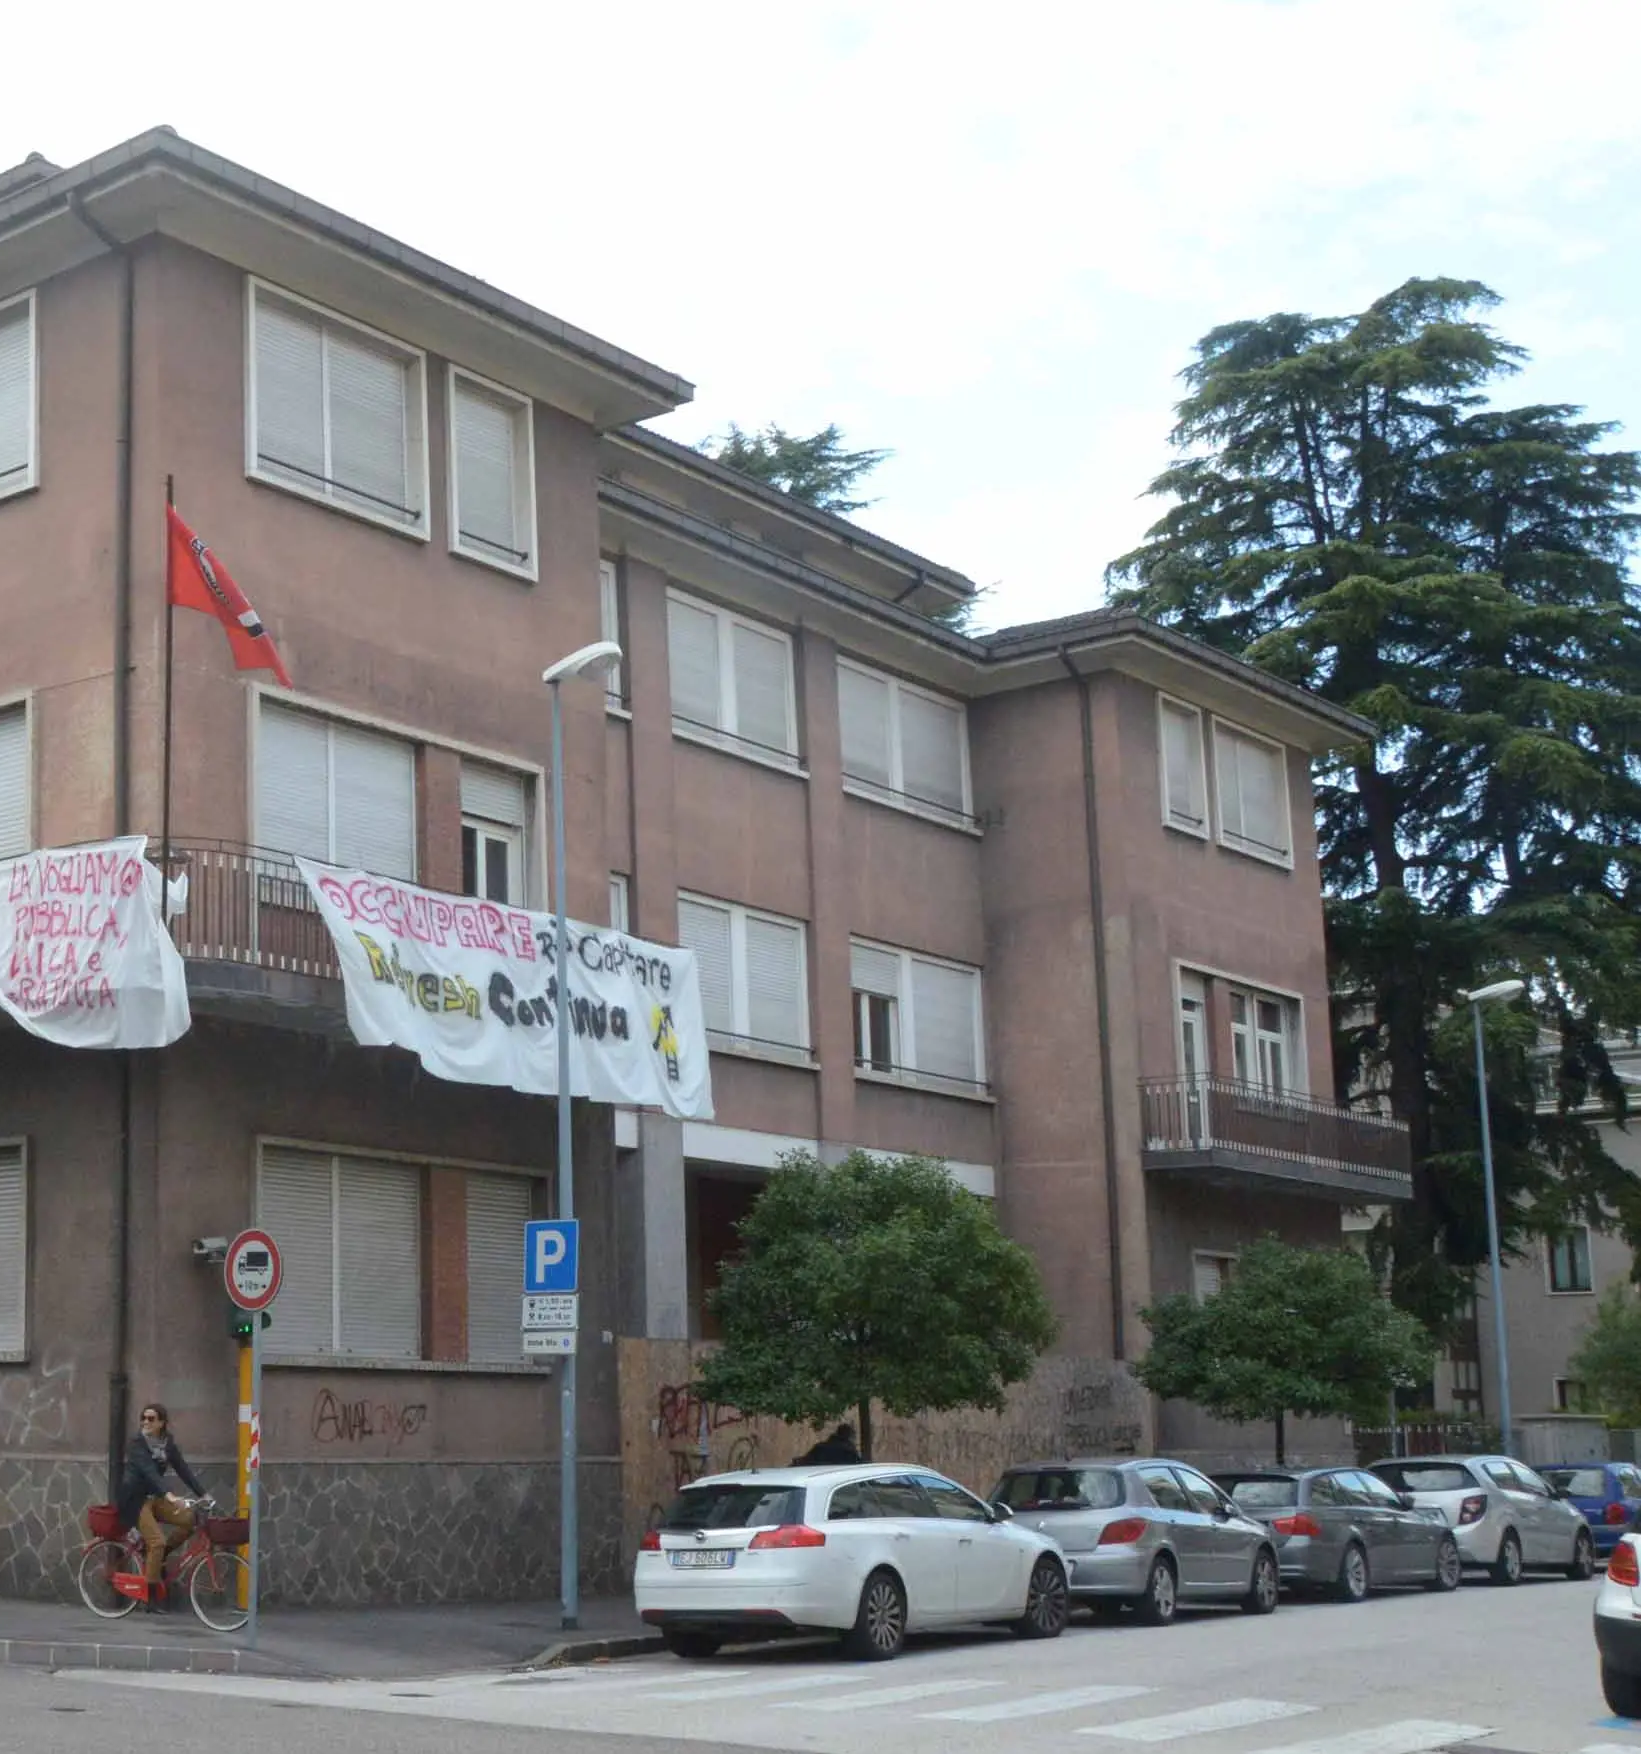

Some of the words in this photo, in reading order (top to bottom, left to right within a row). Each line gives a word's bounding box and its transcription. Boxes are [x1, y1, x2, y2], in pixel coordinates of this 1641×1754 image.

[8, 861, 32, 902] LA
[319, 876, 537, 963] OCCUPARE
[535, 1229, 566, 1284] P
